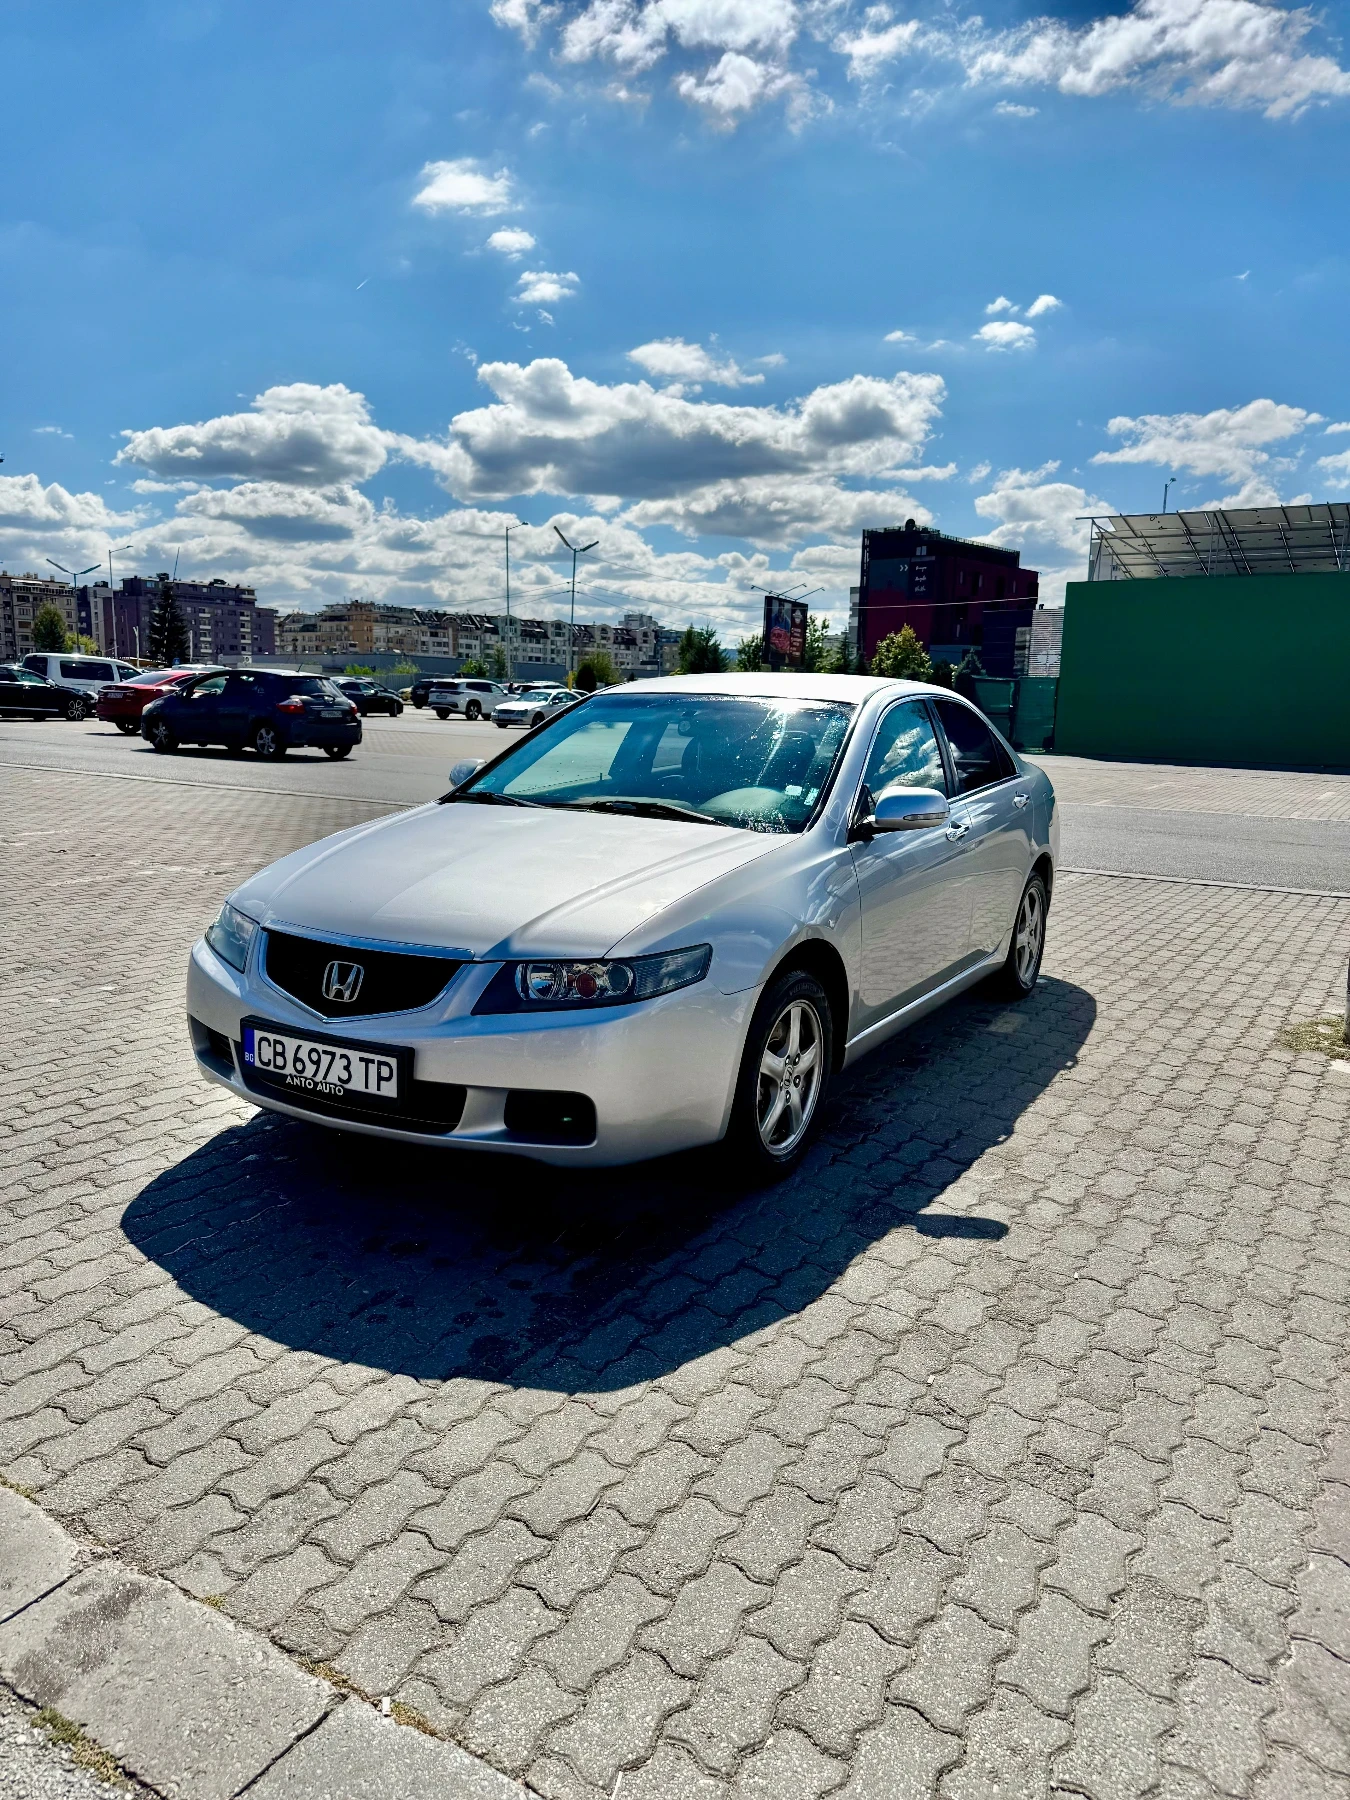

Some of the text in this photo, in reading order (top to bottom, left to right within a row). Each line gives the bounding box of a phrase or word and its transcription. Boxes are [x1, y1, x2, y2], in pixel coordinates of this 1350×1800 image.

[244, 1051, 254, 1063] BG
[257, 1036, 394, 1092] CB 6973 TP
[285, 1073, 344, 1096] ANTO AUTO
